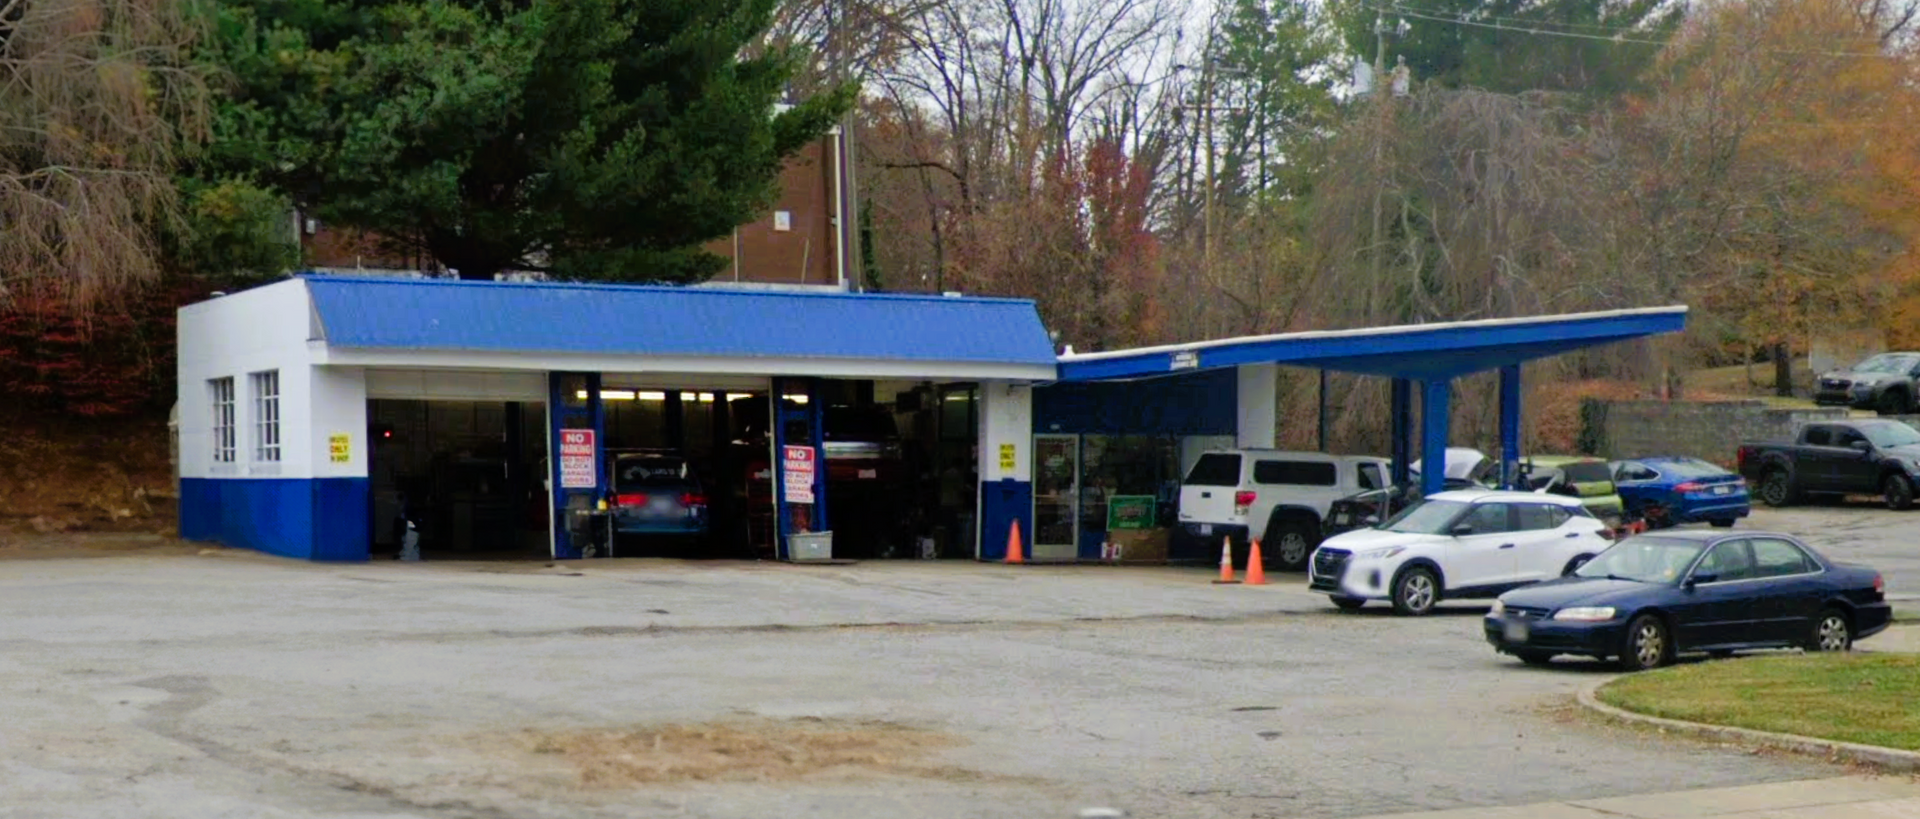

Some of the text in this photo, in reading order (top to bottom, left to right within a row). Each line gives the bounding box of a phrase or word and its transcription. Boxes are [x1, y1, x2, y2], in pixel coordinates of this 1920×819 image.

[566, 433, 584, 443] NO
[561, 444, 591, 454] PARKING
[788, 450, 806, 460] NO
[784, 460, 812, 470] PARKING
